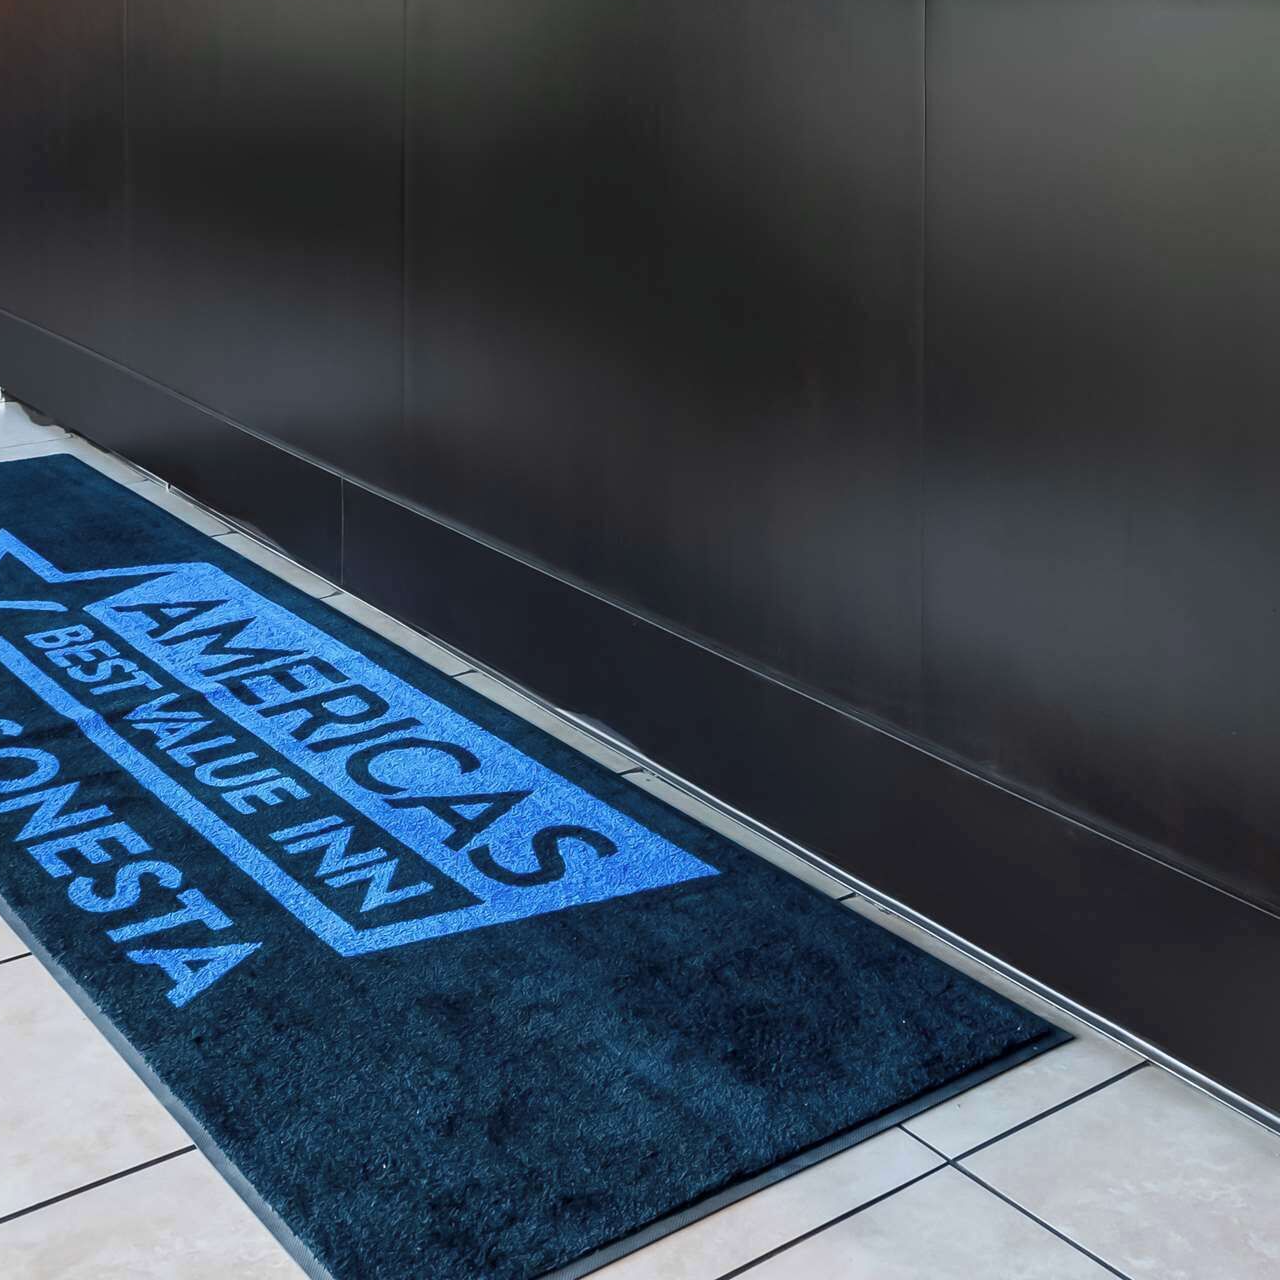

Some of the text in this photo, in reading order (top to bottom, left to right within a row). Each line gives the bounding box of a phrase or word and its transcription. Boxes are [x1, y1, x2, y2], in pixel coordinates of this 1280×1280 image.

[24, 624, 434, 913] BEST VALUE INN
[111, 598, 618, 888] AMERICAS
